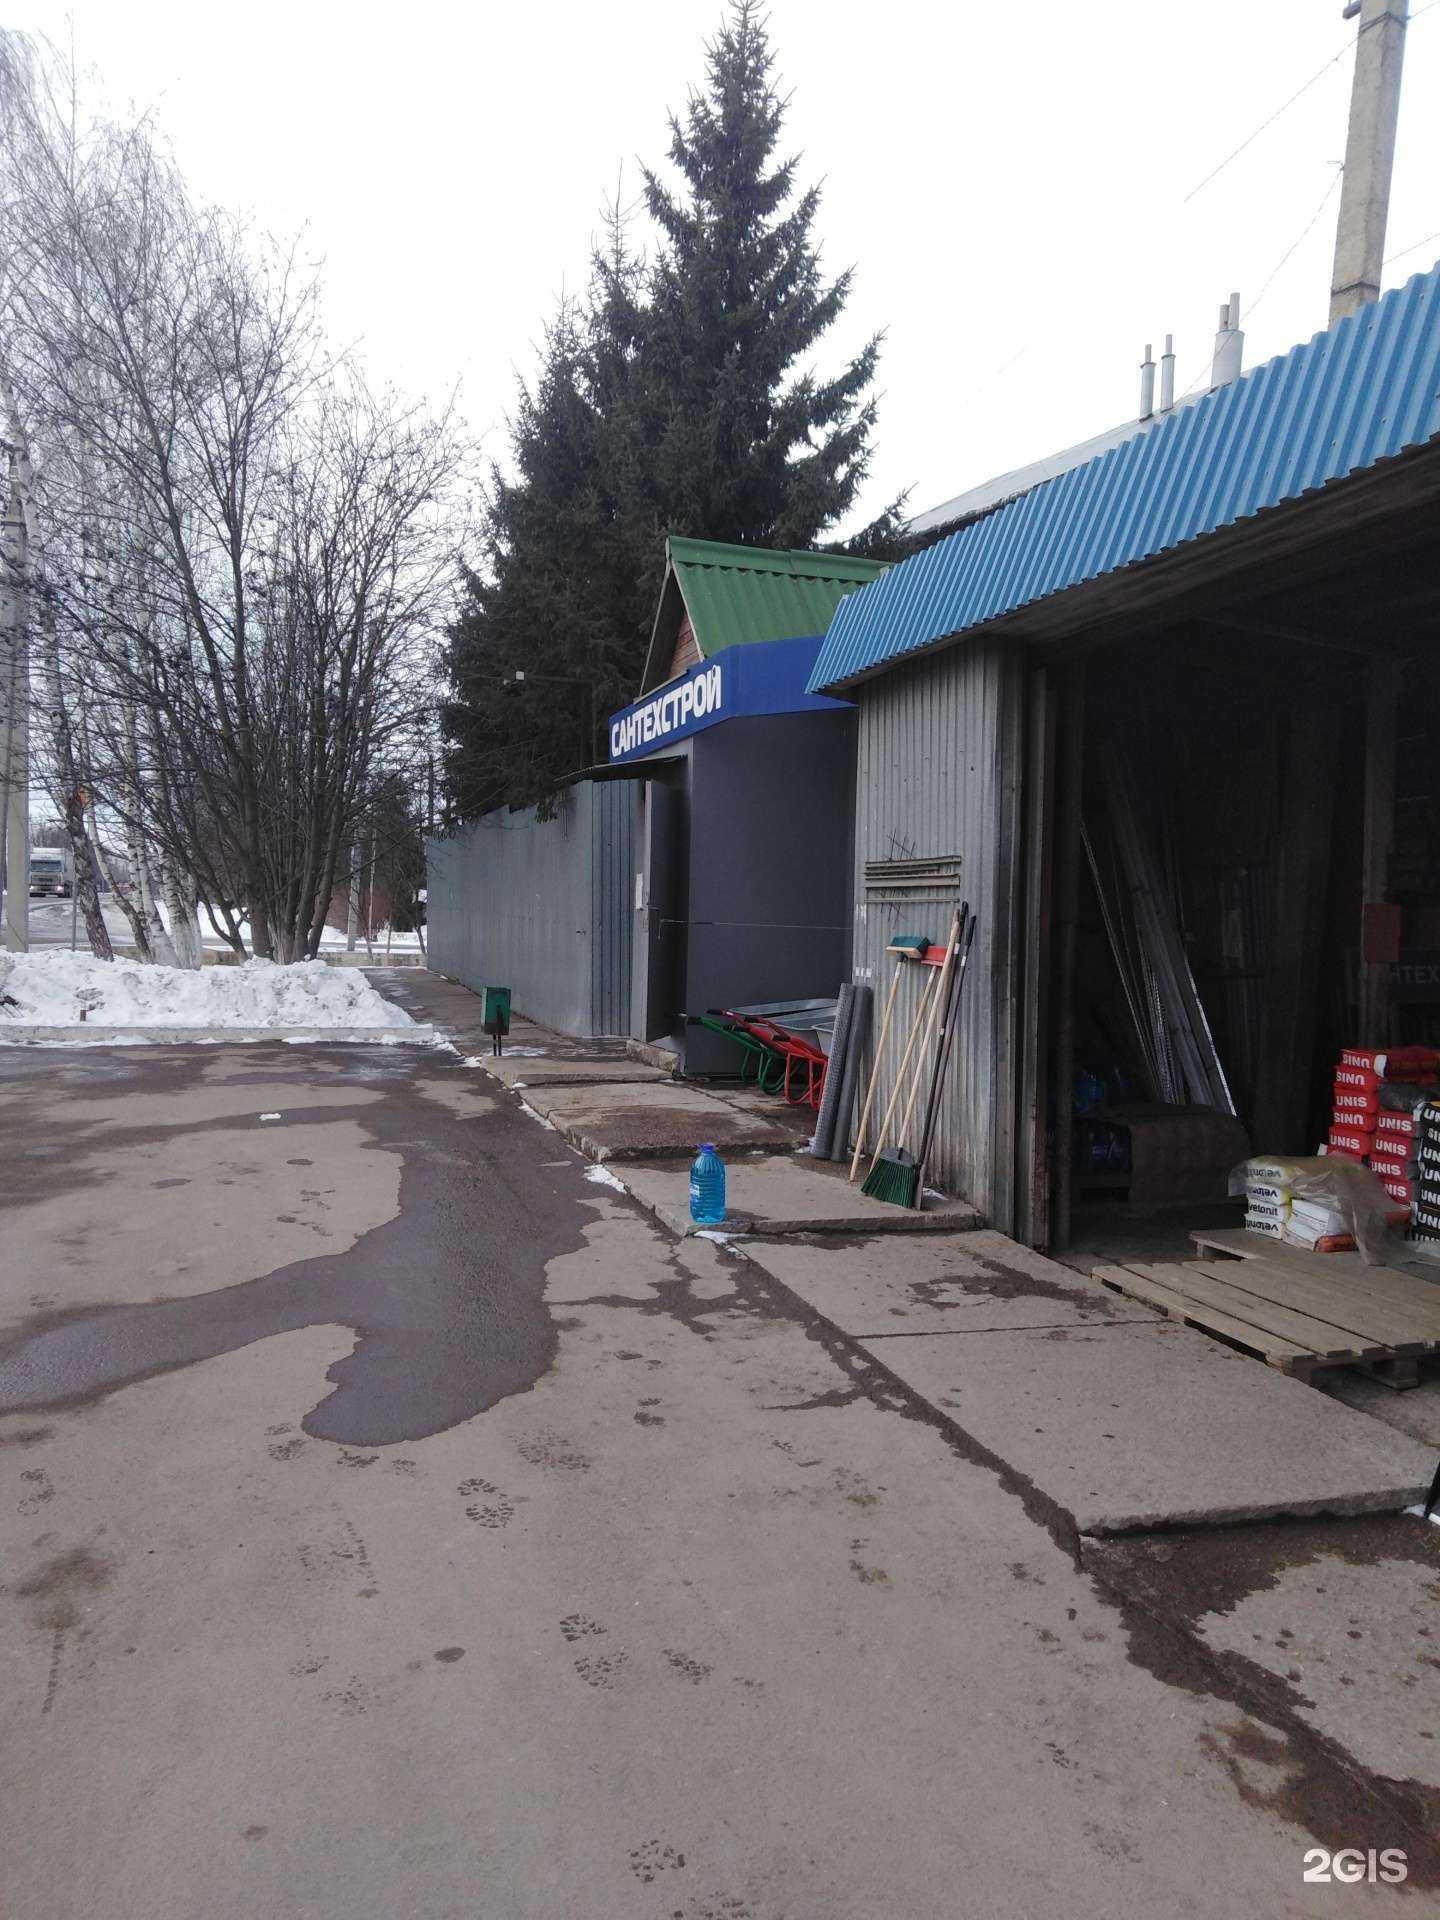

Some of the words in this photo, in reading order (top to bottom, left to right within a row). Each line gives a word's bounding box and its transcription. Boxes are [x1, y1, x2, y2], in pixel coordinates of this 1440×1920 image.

[611, 664, 721, 758] САНТЕХСТРОЙ
[1342, 1053, 1371, 1069] UNIS
[1335, 1071, 1366, 1086] UNIS
[1336, 1095, 1368, 1108] UNIS
[1333, 1112, 1365, 1125] UNIS
[1378, 1116, 1413, 1132] UNIS
[1329, 1134, 1361, 1150] UNIS
[1375, 1139, 1407, 1156] UNIS
[1384, 1183, 1407, 1197] NIS
